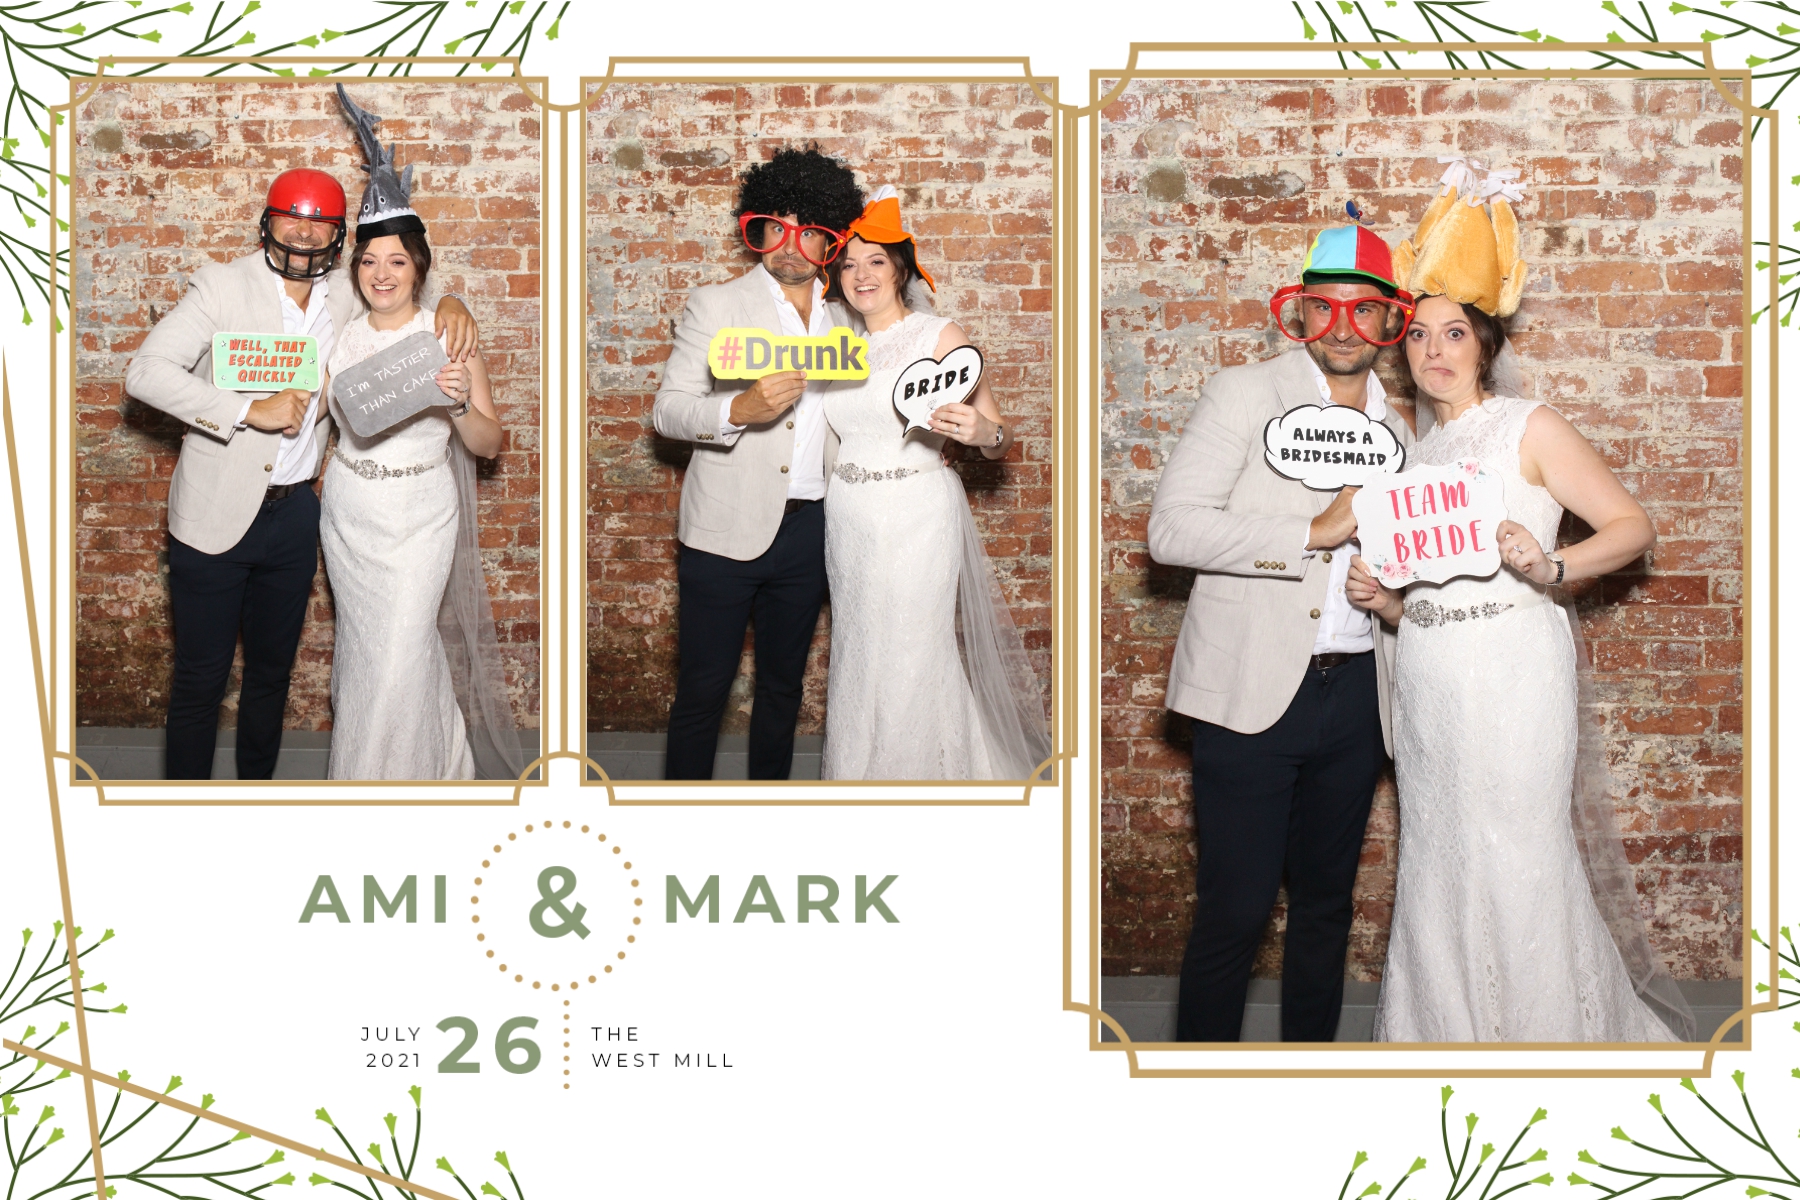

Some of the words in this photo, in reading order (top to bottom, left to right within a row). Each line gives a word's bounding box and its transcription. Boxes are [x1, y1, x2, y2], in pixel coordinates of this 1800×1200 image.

[229, 338, 267, 354] WELL,
[273, 340, 307, 353] THAT
[717, 335, 863, 371] #Drunk
[228, 354, 303, 368] ESCALATED
[237, 369, 296, 383] QUICKLY
[904, 365, 970, 401] BRIDE
[348, 380, 370, 398] I'm
[359, 390, 397, 415] THAN
[402, 368, 439, 394] CAKE
[1293, 427, 1356, 444] ALWAYS
[1362, 431, 1374, 445] A
[1280, 447, 1387, 467] BRIDESMAID
[1385, 480, 1470, 521] TEAM
[1393, 519, 1487, 564] BRIDE
